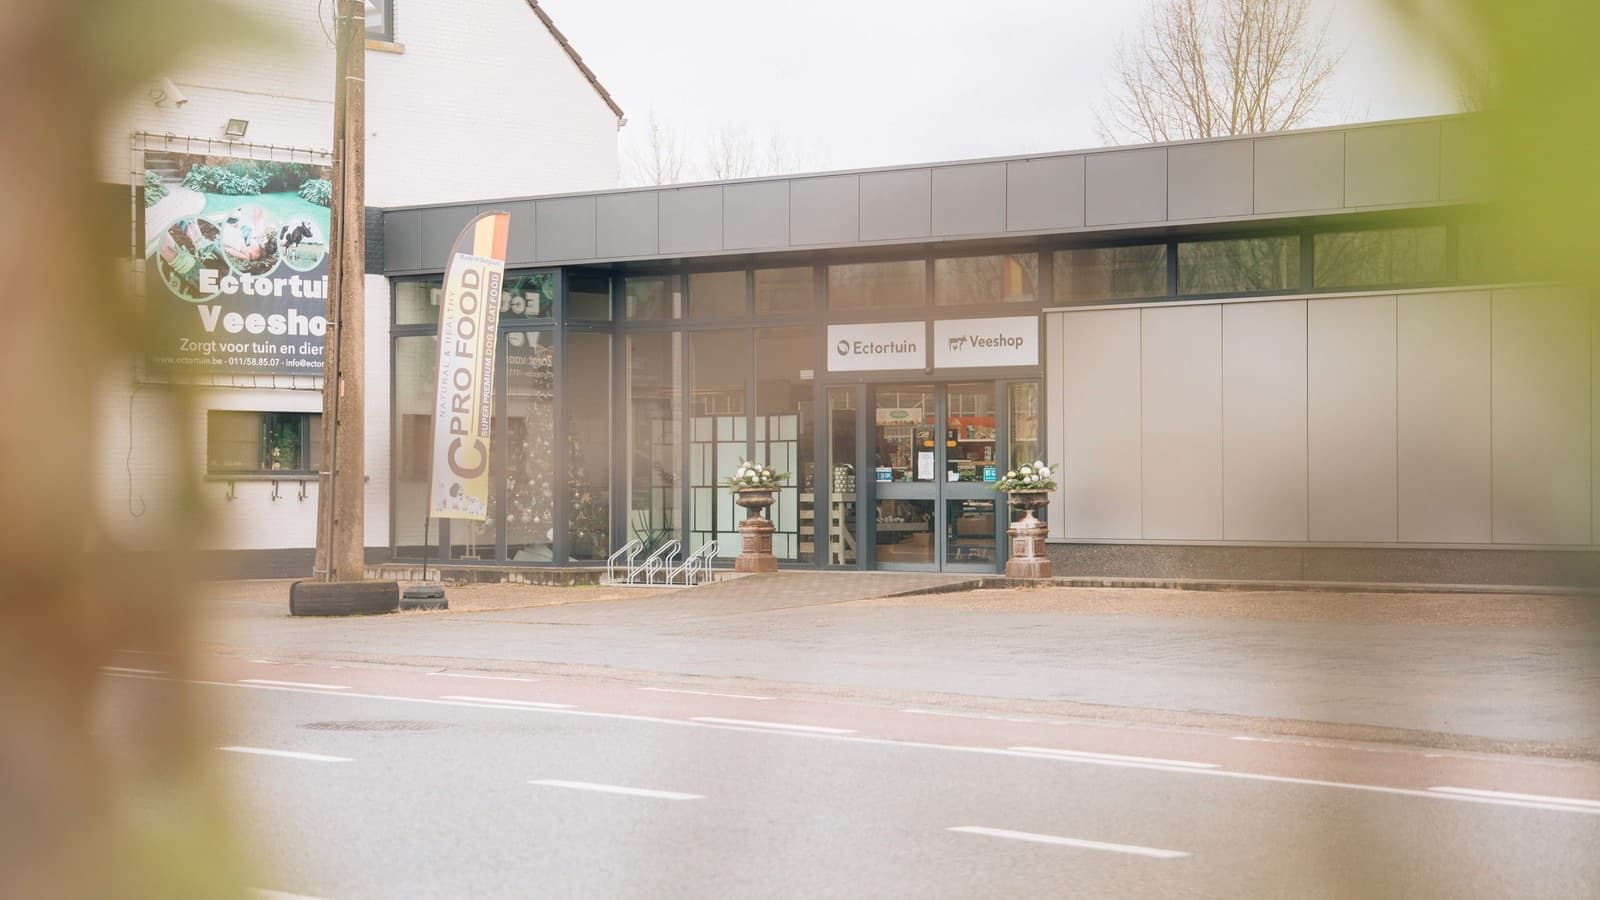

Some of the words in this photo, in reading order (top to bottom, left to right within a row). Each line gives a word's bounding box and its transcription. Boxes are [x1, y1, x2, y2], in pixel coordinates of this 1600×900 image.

[199, 268, 328, 299] Ectortui
[490, 273, 500, 303] FOOD
[197, 304, 327, 336] Veesho
[455, 268, 480, 359] FOOD
[489, 303, 497, 323] CAT
[179, 338, 217, 355] Zorgt
[219, 343, 250, 353] voor
[252, 342, 277, 354] tuin
[281, 344, 296, 354] en
[299, 341, 324, 355] dier
[440, 363, 450, 417] NATURAL
[445, 291, 456, 345] HEALTHY
[486, 333, 494, 355] DOG
[853, 339, 917, 355] Ectortuin
[969, 333, 1024, 349] Veeshop
[228, 357, 280, 367] 011/58.85.07
[285, 358, 325, 368] info@ector
[482, 357, 493, 404] PREMIUM
[480, 405, 490, 437] SUPER
